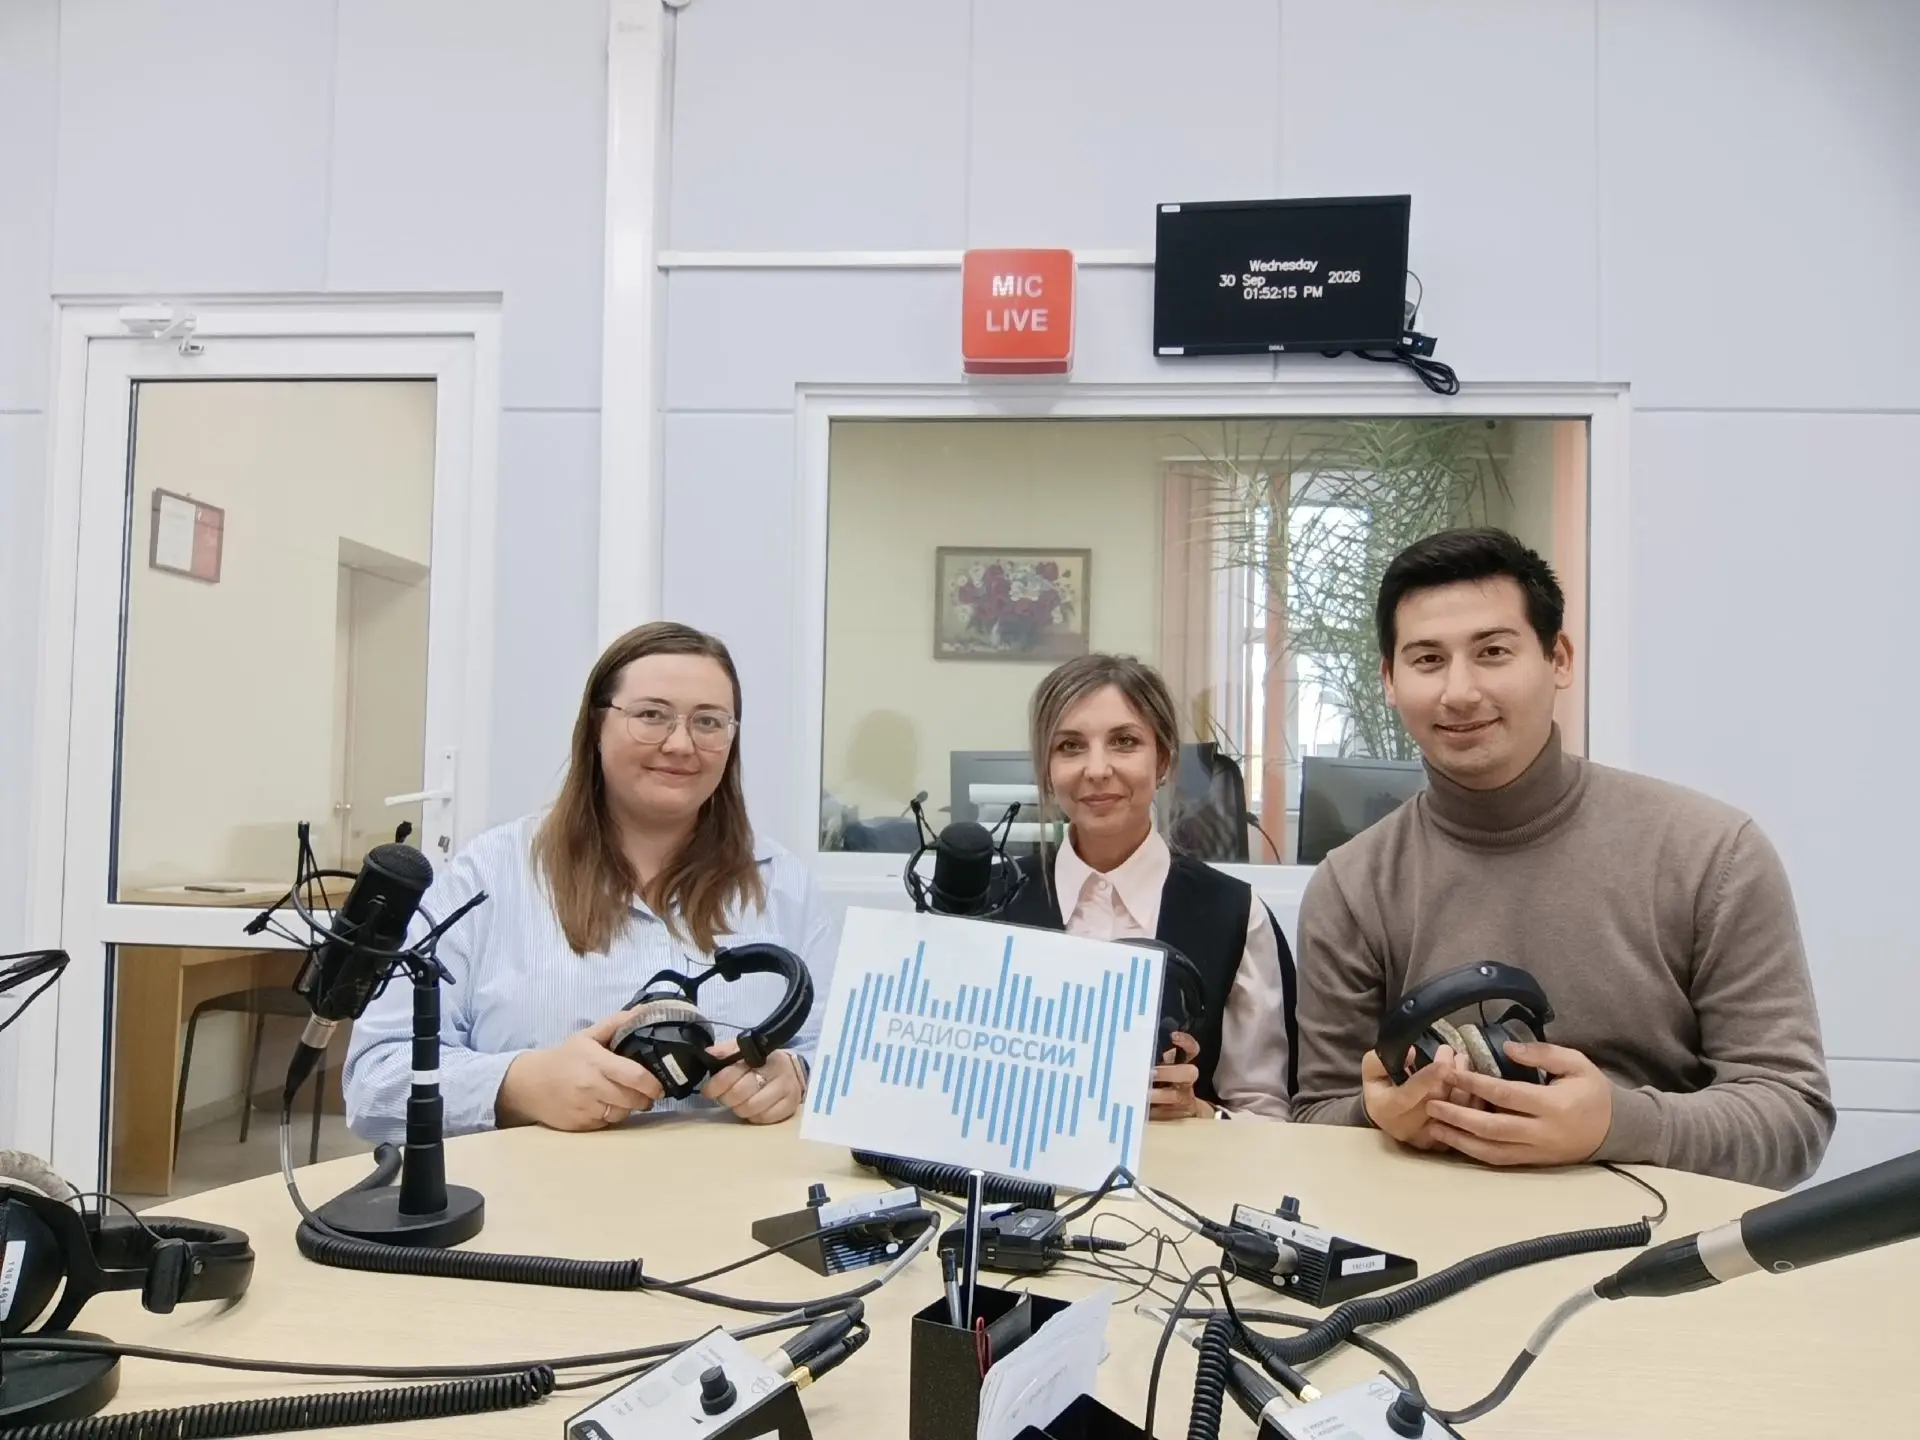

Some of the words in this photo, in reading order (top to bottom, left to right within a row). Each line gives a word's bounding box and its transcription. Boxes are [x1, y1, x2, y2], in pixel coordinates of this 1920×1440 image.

[1249, 258, 1318, 273] Wednesday
[992, 275, 1043, 297] MIC
[1219, 274, 1236, 287] 30
[1242, 273, 1266, 288] Sep
[1328, 270, 1361, 284] 2026
[1243, 285, 1297, 300] 01:52:15
[1303, 285, 1323, 298] PM
[986, 309, 1049, 332] LIVE
